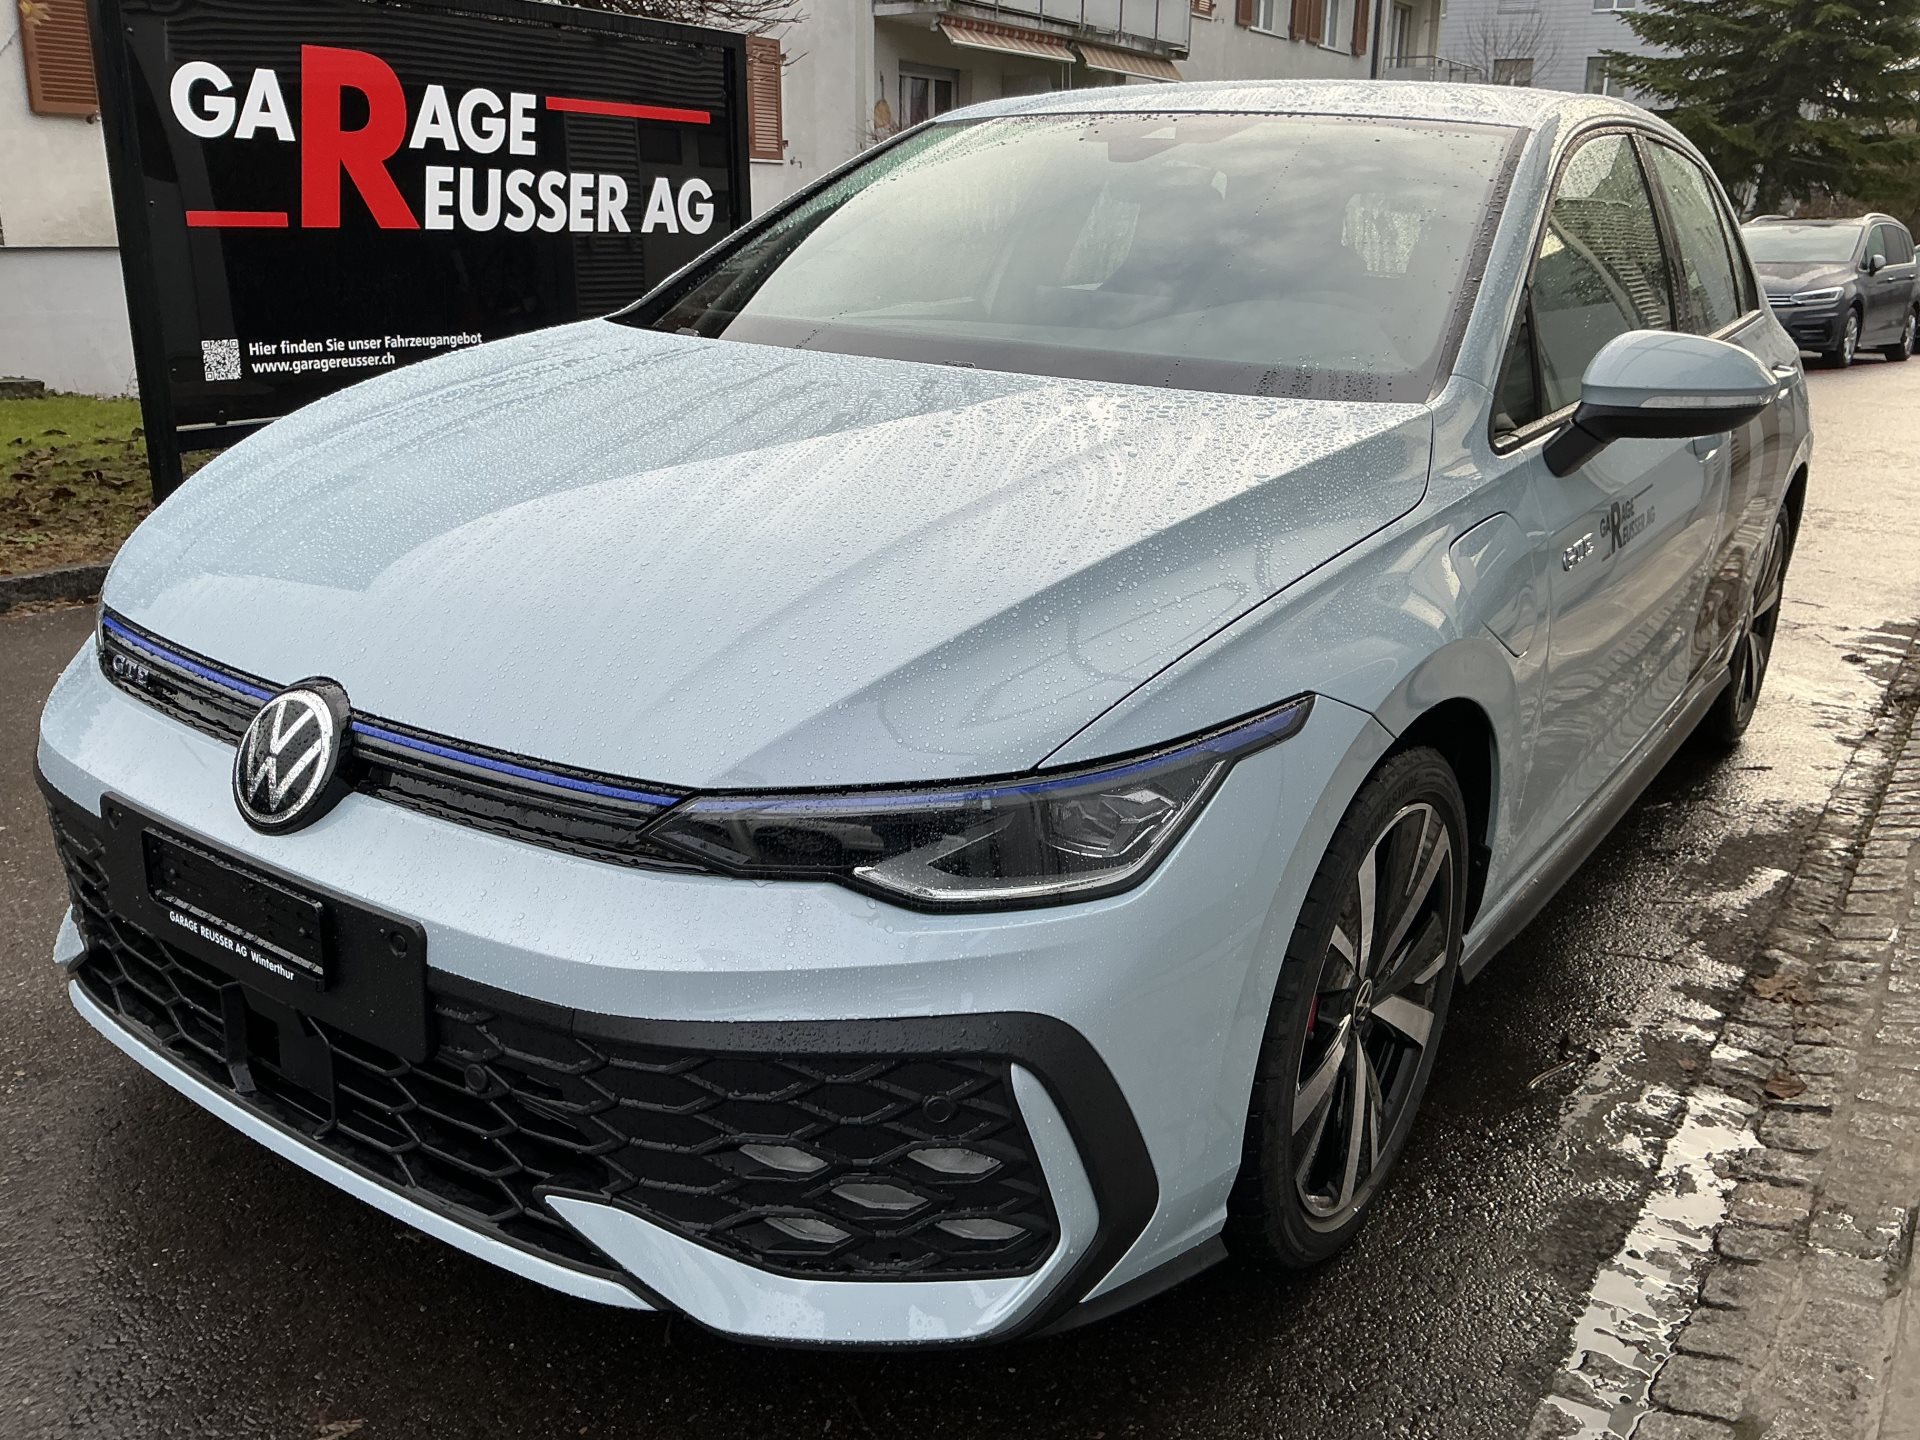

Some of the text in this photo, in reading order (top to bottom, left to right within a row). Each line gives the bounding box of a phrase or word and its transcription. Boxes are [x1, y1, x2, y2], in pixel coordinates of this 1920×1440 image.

[169, 43, 537, 229] GARAGE
[641, 178, 715, 235] AG
[249, 331, 483, 356] Hier finden Sie unser Fahrzeugangebot
[251, 352, 396, 374] www.garagereusser.ch
[111, 654, 150, 684] GTE
[169, 910, 295, 981] GARAGE REUSSER AG Winterthur
